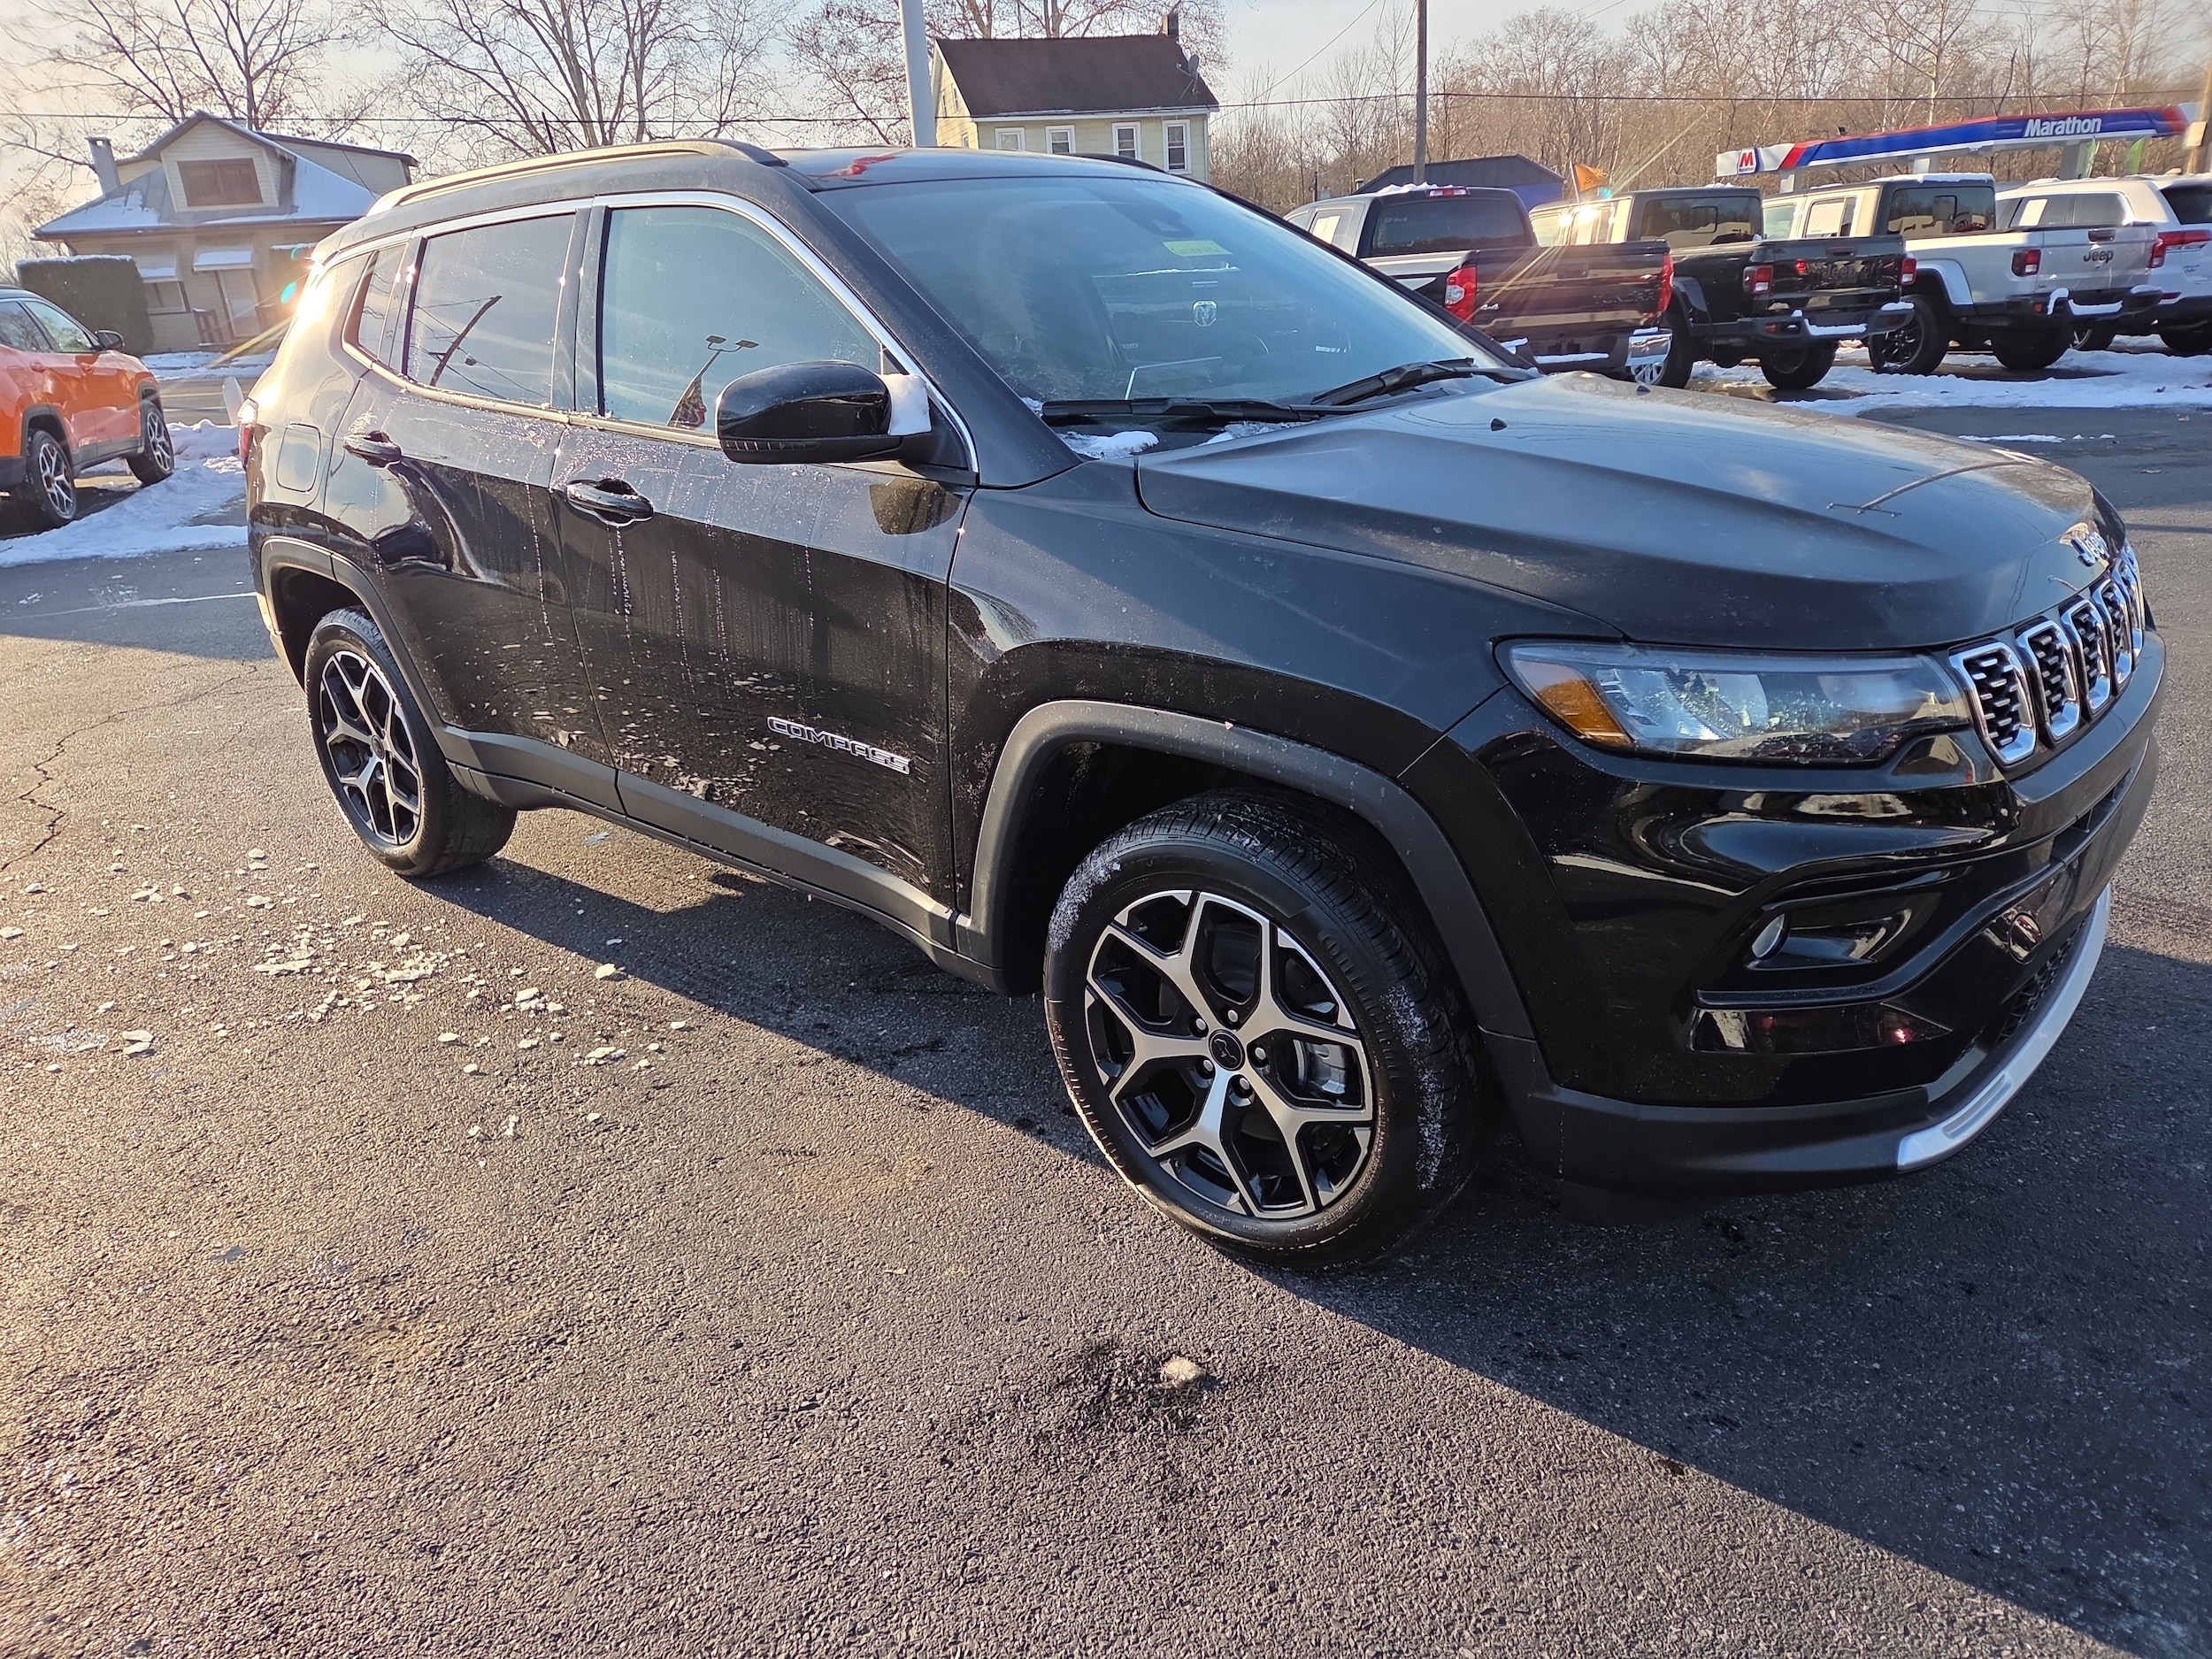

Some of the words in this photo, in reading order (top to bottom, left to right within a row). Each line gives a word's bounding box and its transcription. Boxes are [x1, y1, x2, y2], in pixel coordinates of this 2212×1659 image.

[2024, 116, 2102, 137] Marathon
[1740, 151, 1755, 167] M
[2083, 250, 2114, 264] Jeep
[766, 715, 911, 775] COMPASS
